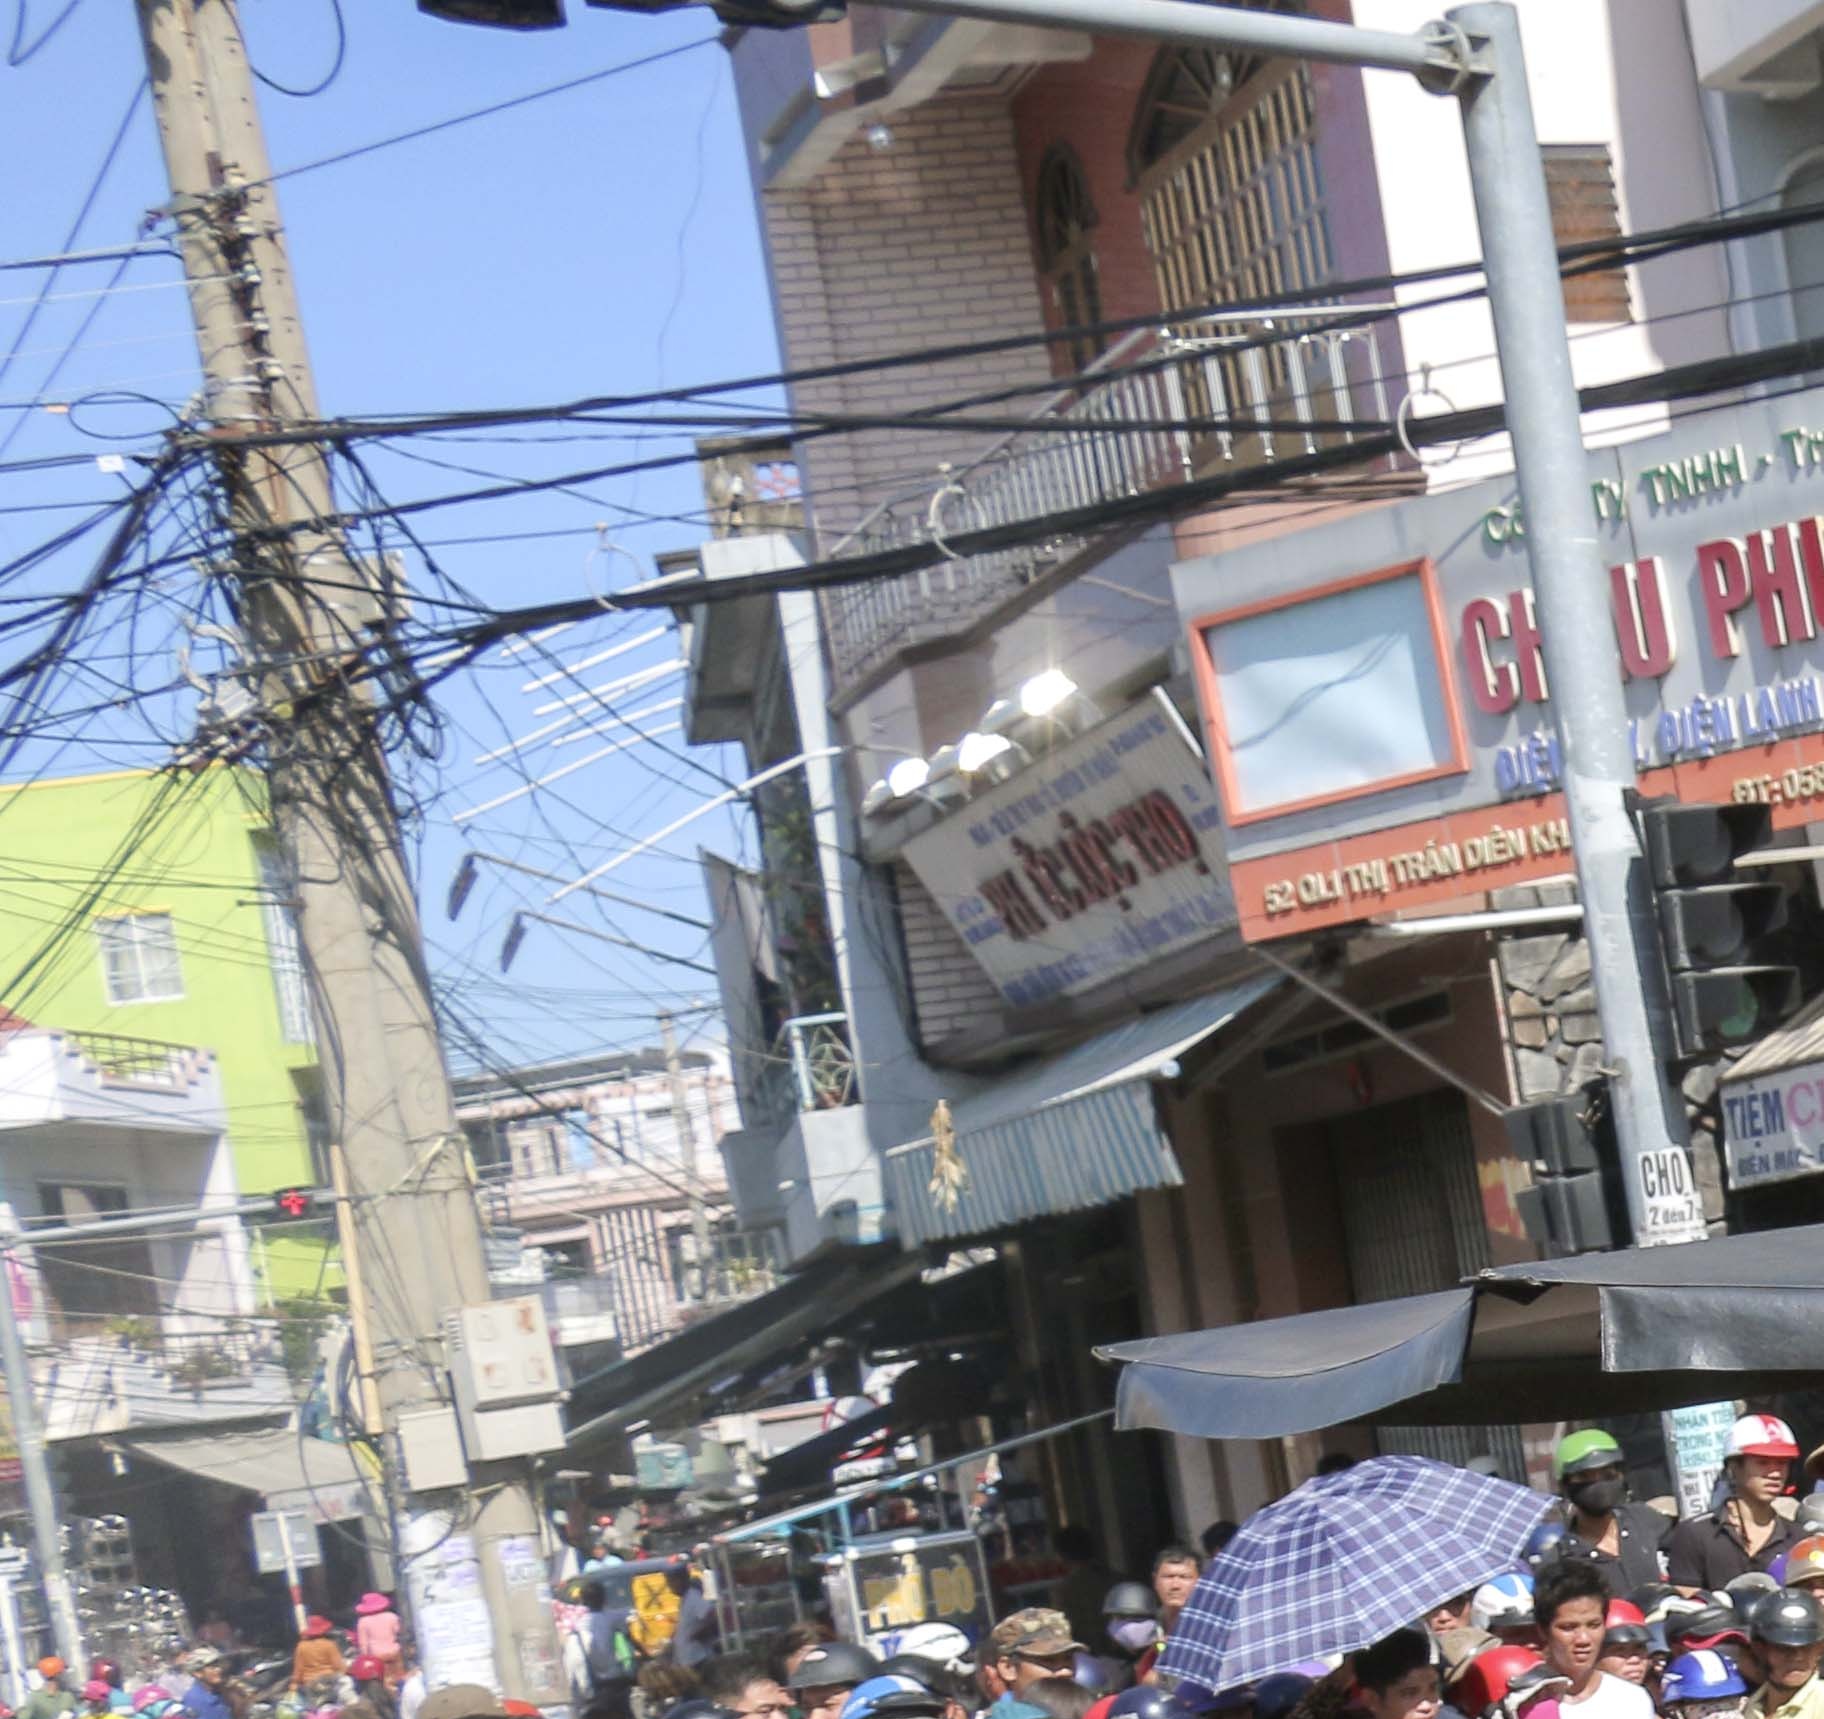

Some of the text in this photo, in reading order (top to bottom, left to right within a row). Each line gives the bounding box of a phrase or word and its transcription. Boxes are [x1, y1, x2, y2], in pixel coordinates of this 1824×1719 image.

[1640, 444, 1749, 506] TNHH
[1462, 556, 1677, 715] CHU
[1658, 693, 1739, 757] ĐIỆN
[1263, 882, 1298, 915] 52
[1391, 838, 1463, 884] TRẤN
[1725, 1081, 1786, 1148] TIỆM
[1640, 1151, 1685, 1199] CHO
